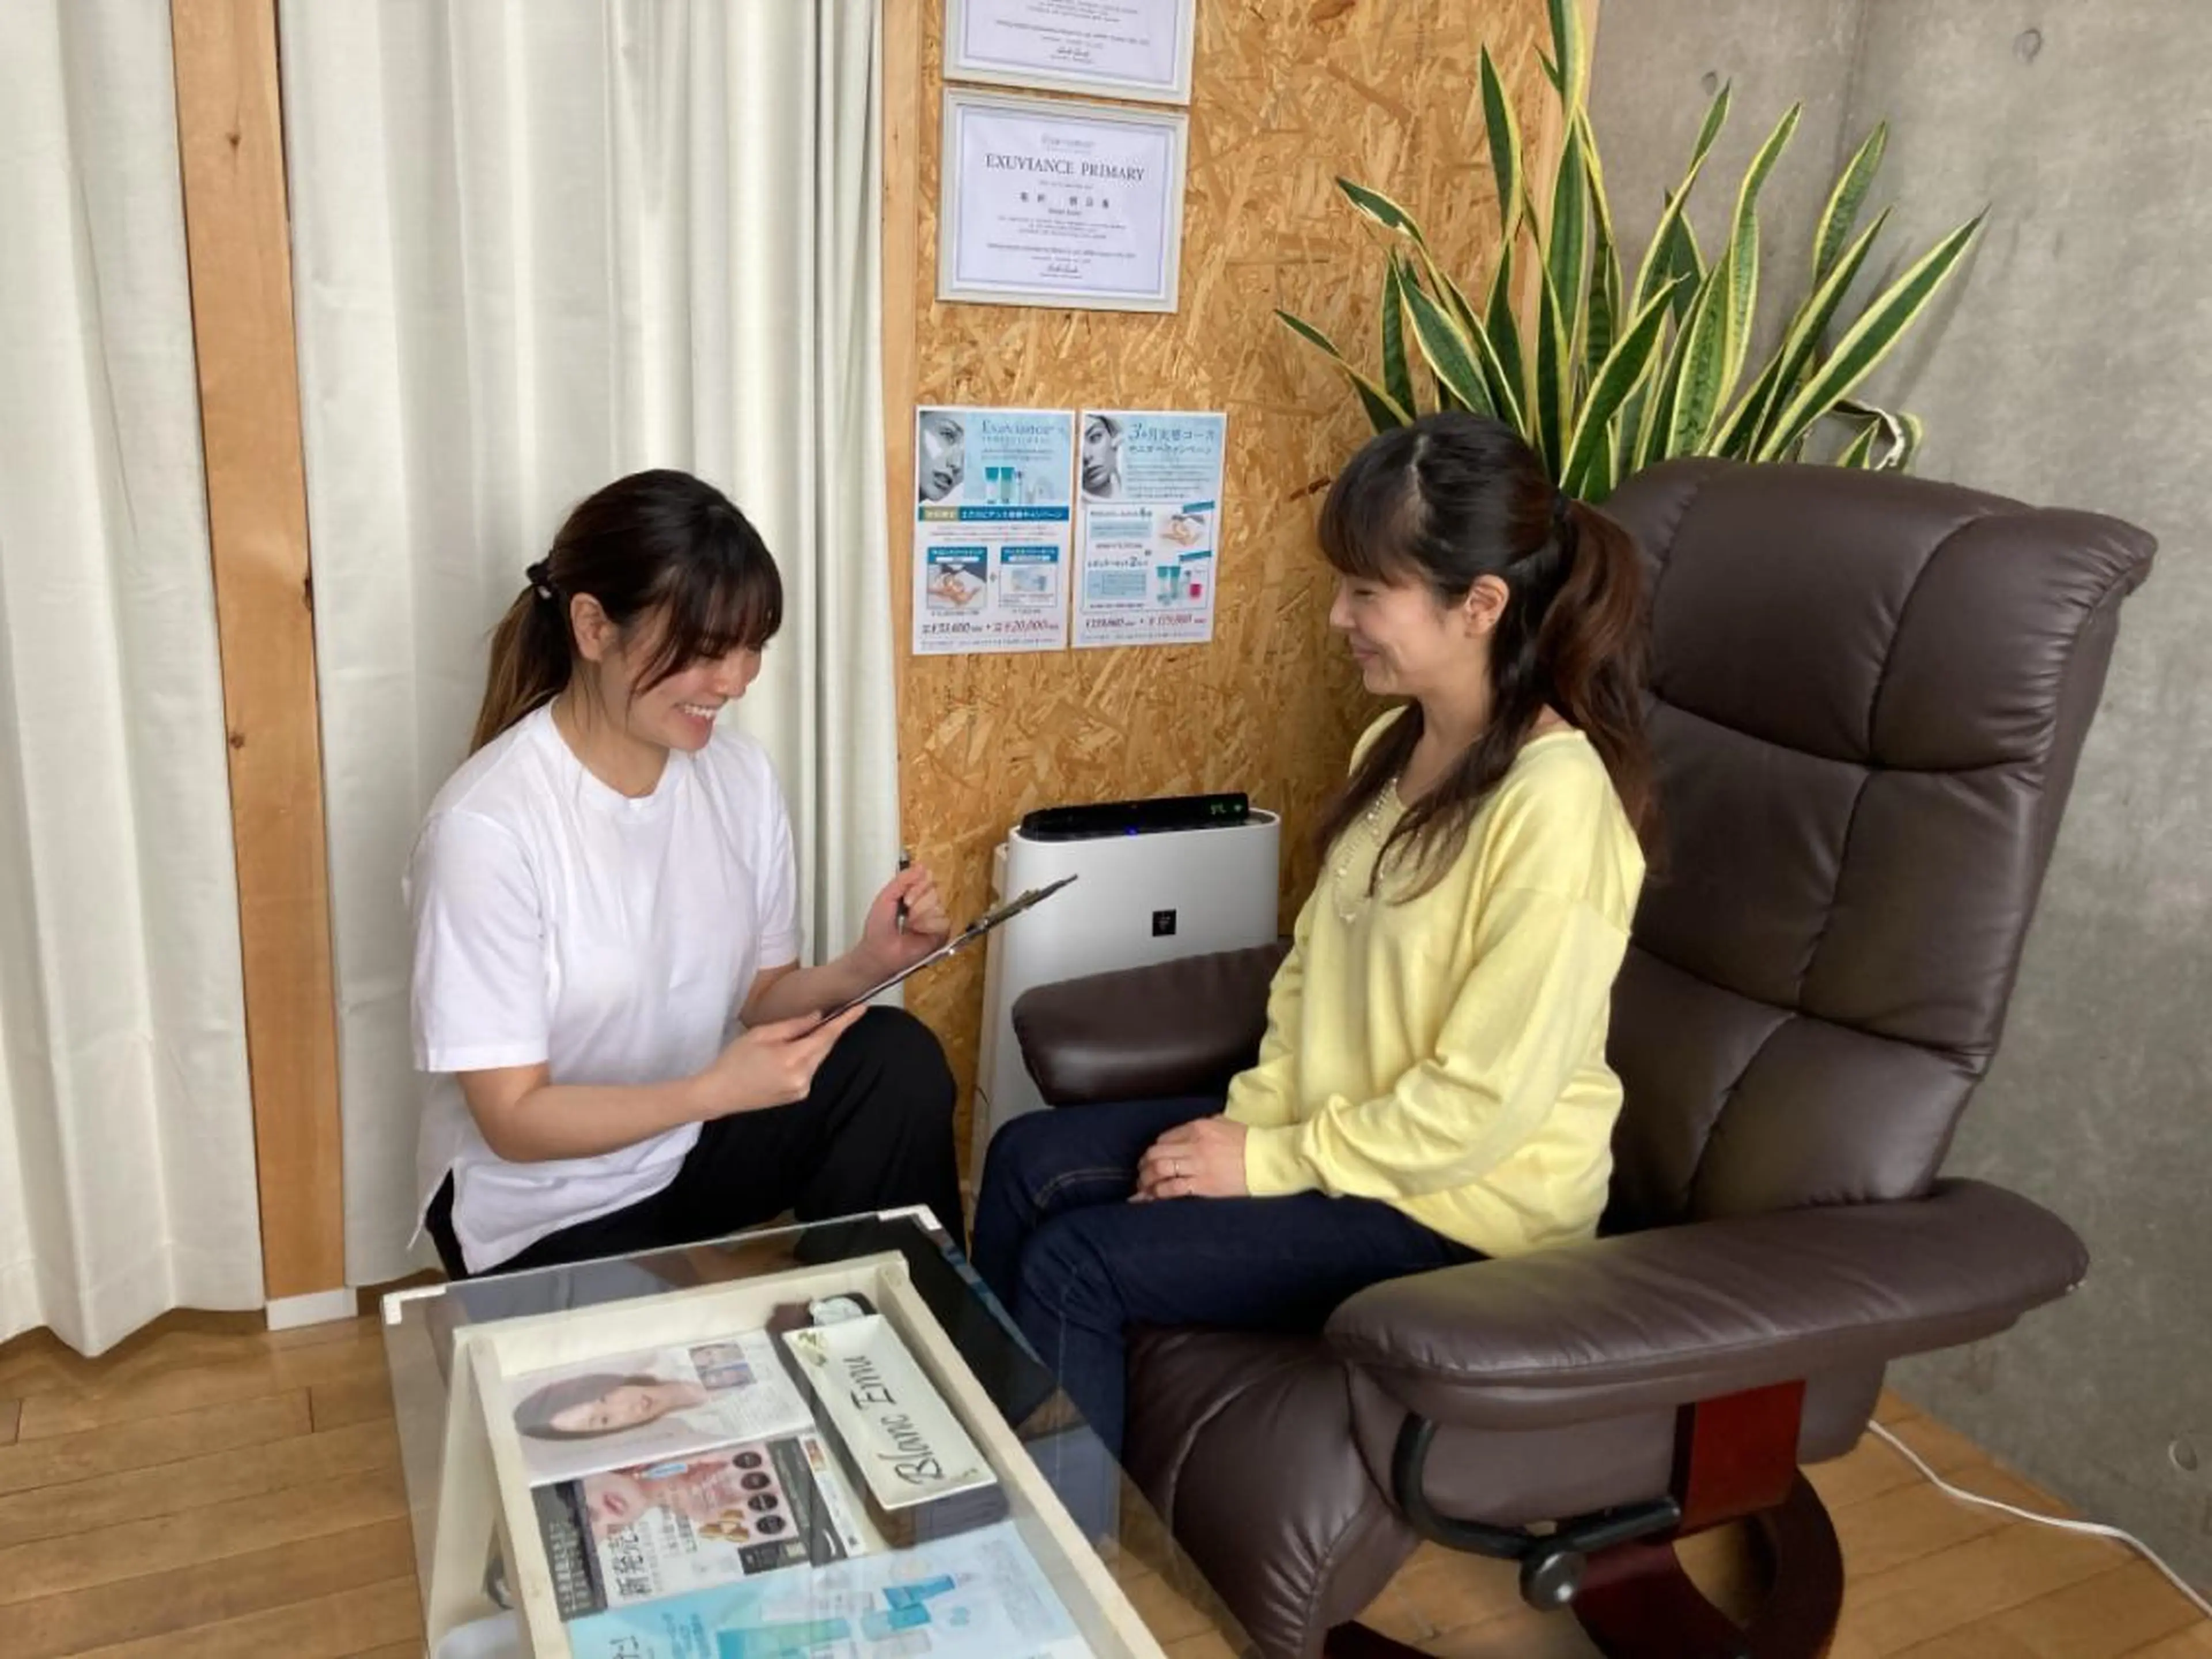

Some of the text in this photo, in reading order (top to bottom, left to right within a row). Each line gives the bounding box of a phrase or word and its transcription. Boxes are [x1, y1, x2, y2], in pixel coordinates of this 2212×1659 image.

[985, 153, 1145, 181] EXUVIANCE PRIMARY
[877, 1414, 945, 1485] Blanc
